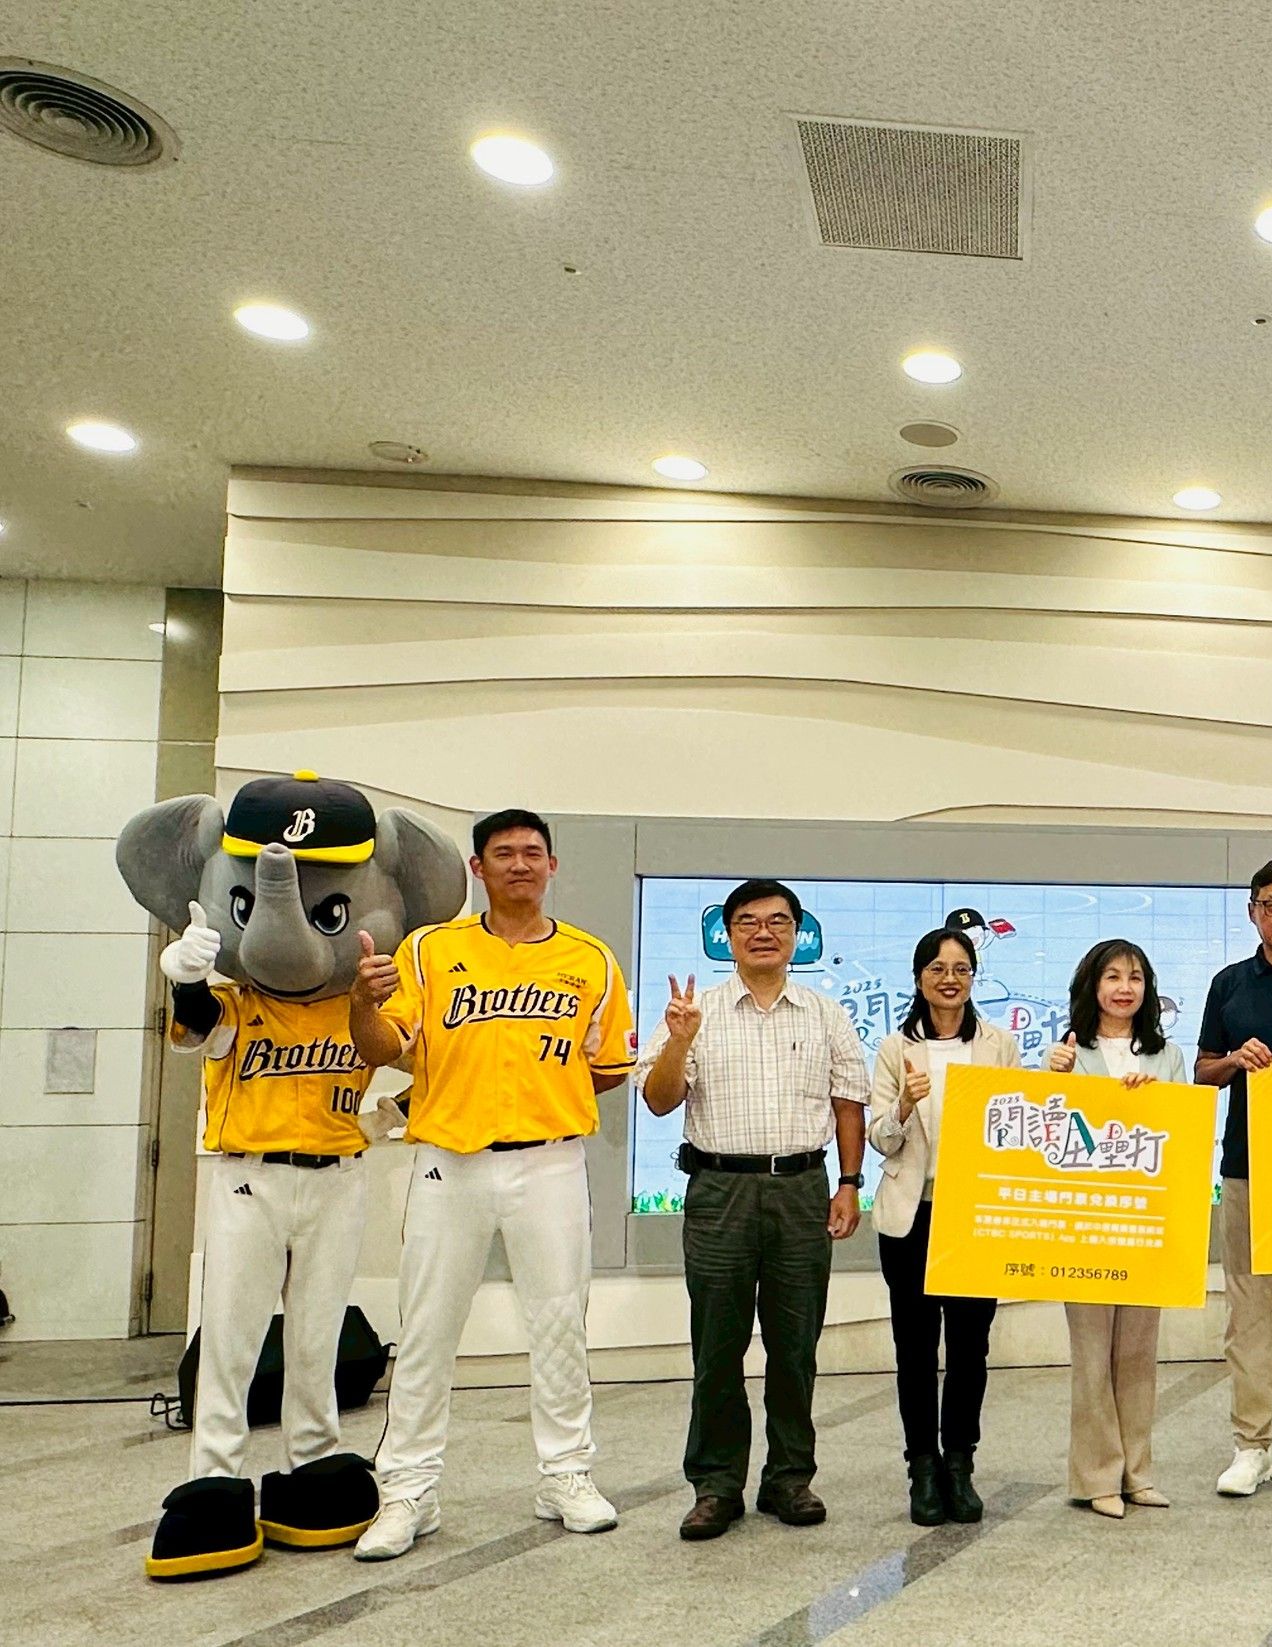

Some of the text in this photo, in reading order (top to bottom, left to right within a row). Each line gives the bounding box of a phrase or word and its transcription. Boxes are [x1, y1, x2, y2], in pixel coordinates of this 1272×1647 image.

[283, 808, 316, 842] B
[841, 979, 882, 996] 2025
[443, 982, 581, 1030] Brothers
[239, 1035, 367, 1081] Brother
[539, 1034, 572, 1066] 74
[992, 1095, 1020, 1106] 2025
